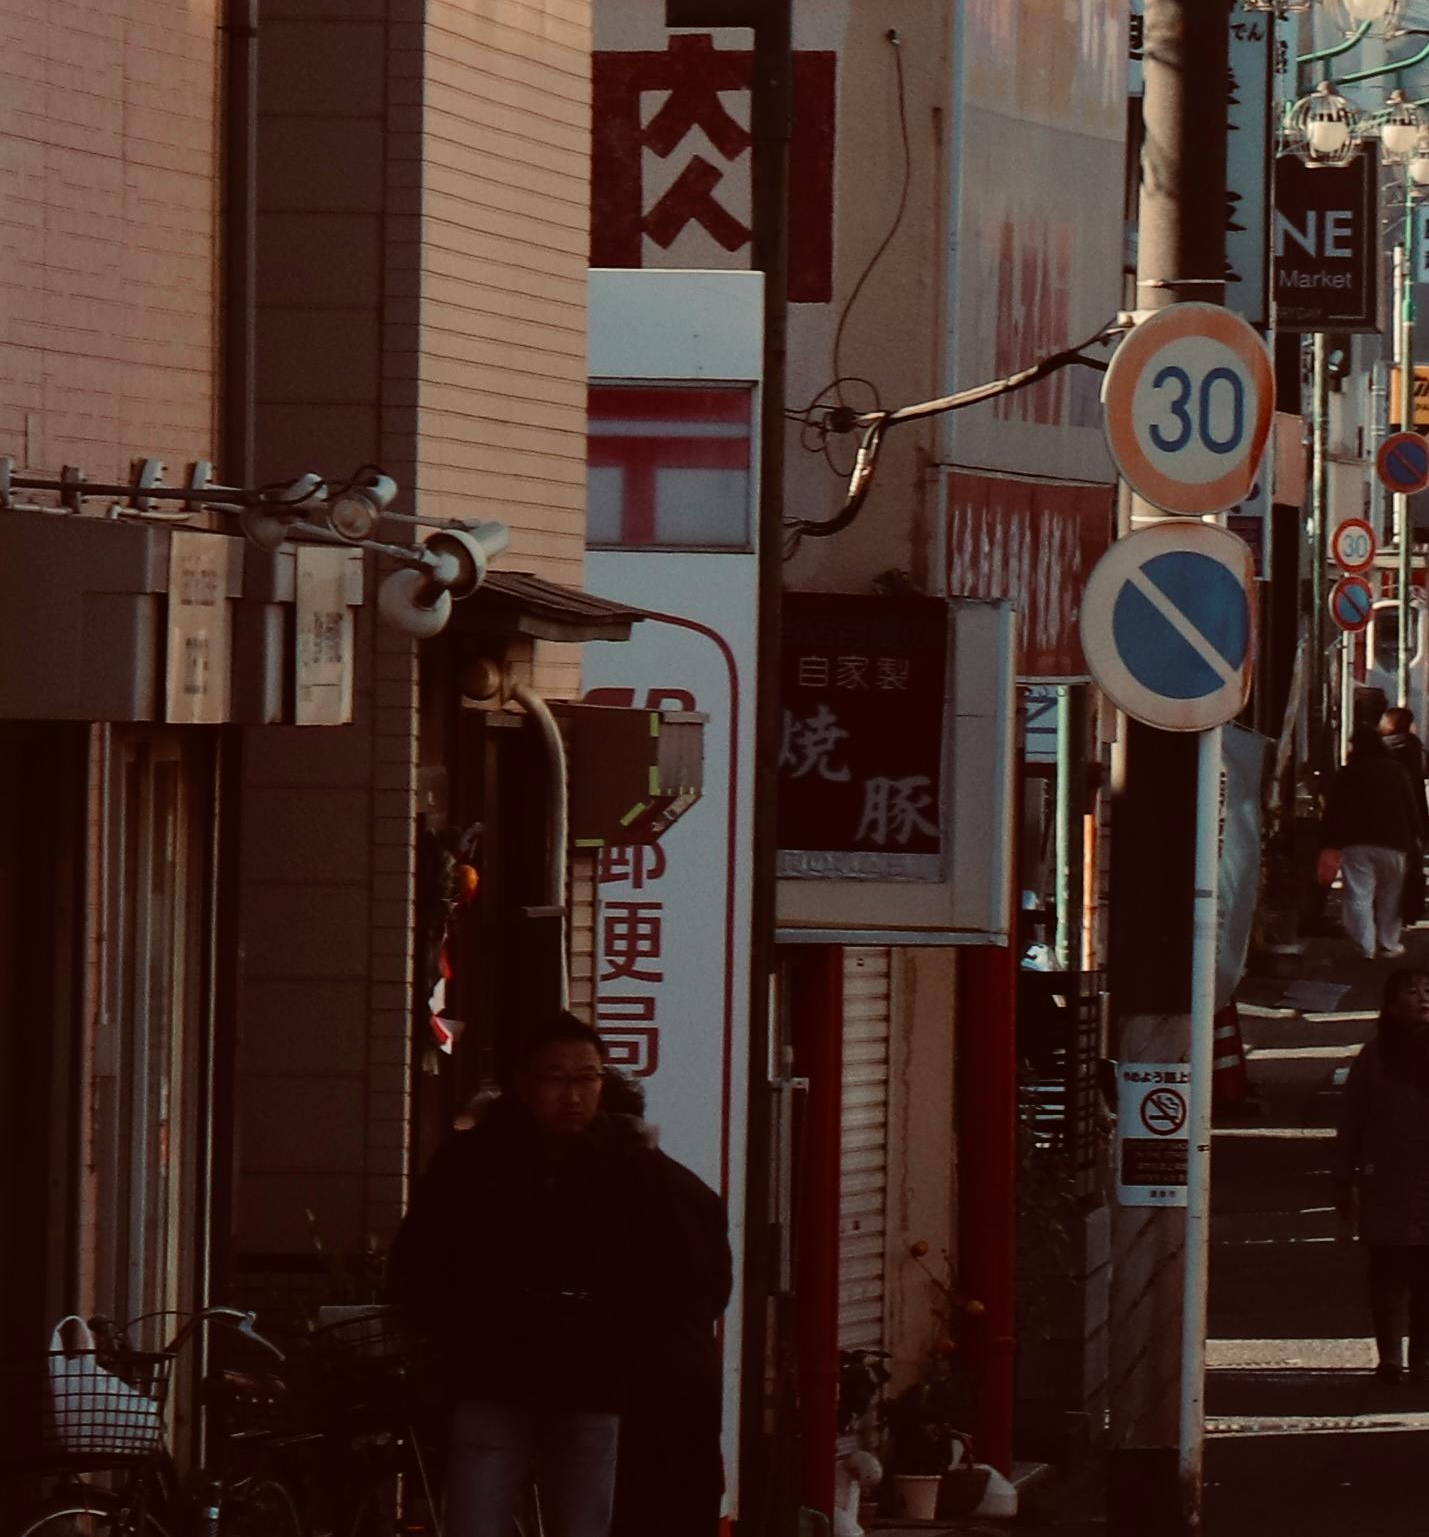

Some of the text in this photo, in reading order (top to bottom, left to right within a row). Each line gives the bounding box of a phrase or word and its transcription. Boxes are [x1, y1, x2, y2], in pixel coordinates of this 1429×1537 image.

[590, 34, 837, 303] 肉
[1280, 270, 1353, 288] Market
[1148, 365, 1244, 454] 30
[1343, 535, 1367, 559] 30
[798, 655, 911, 692] 自家製
[779, 703, 940, 845] 焼豚
